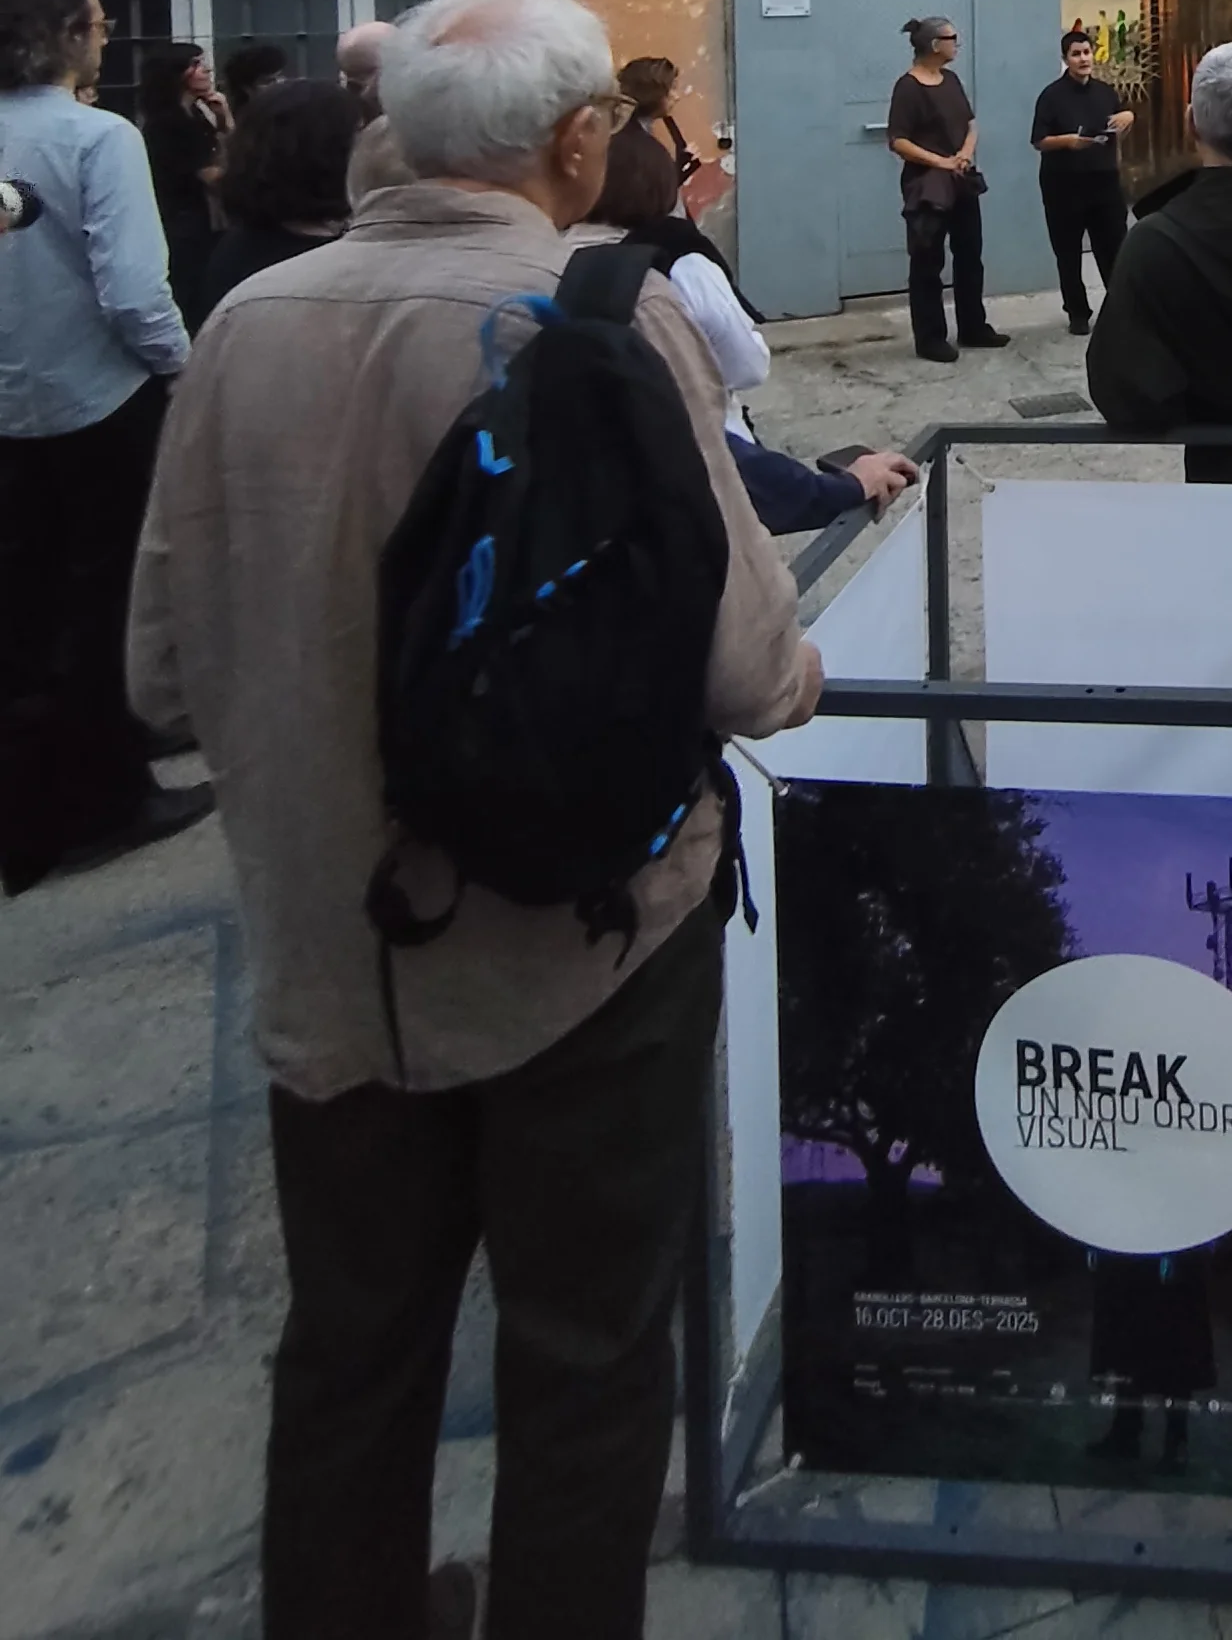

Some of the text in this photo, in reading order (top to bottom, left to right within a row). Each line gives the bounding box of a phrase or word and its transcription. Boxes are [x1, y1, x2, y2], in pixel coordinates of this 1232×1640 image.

[1016, 1039, 1191, 1103] BREAK
[1017, 1085, 1060, 1118] UN
[1074, 1087, 1140, 1125] NOU
[1017, 1116, 1128, 1152] VISUAL
